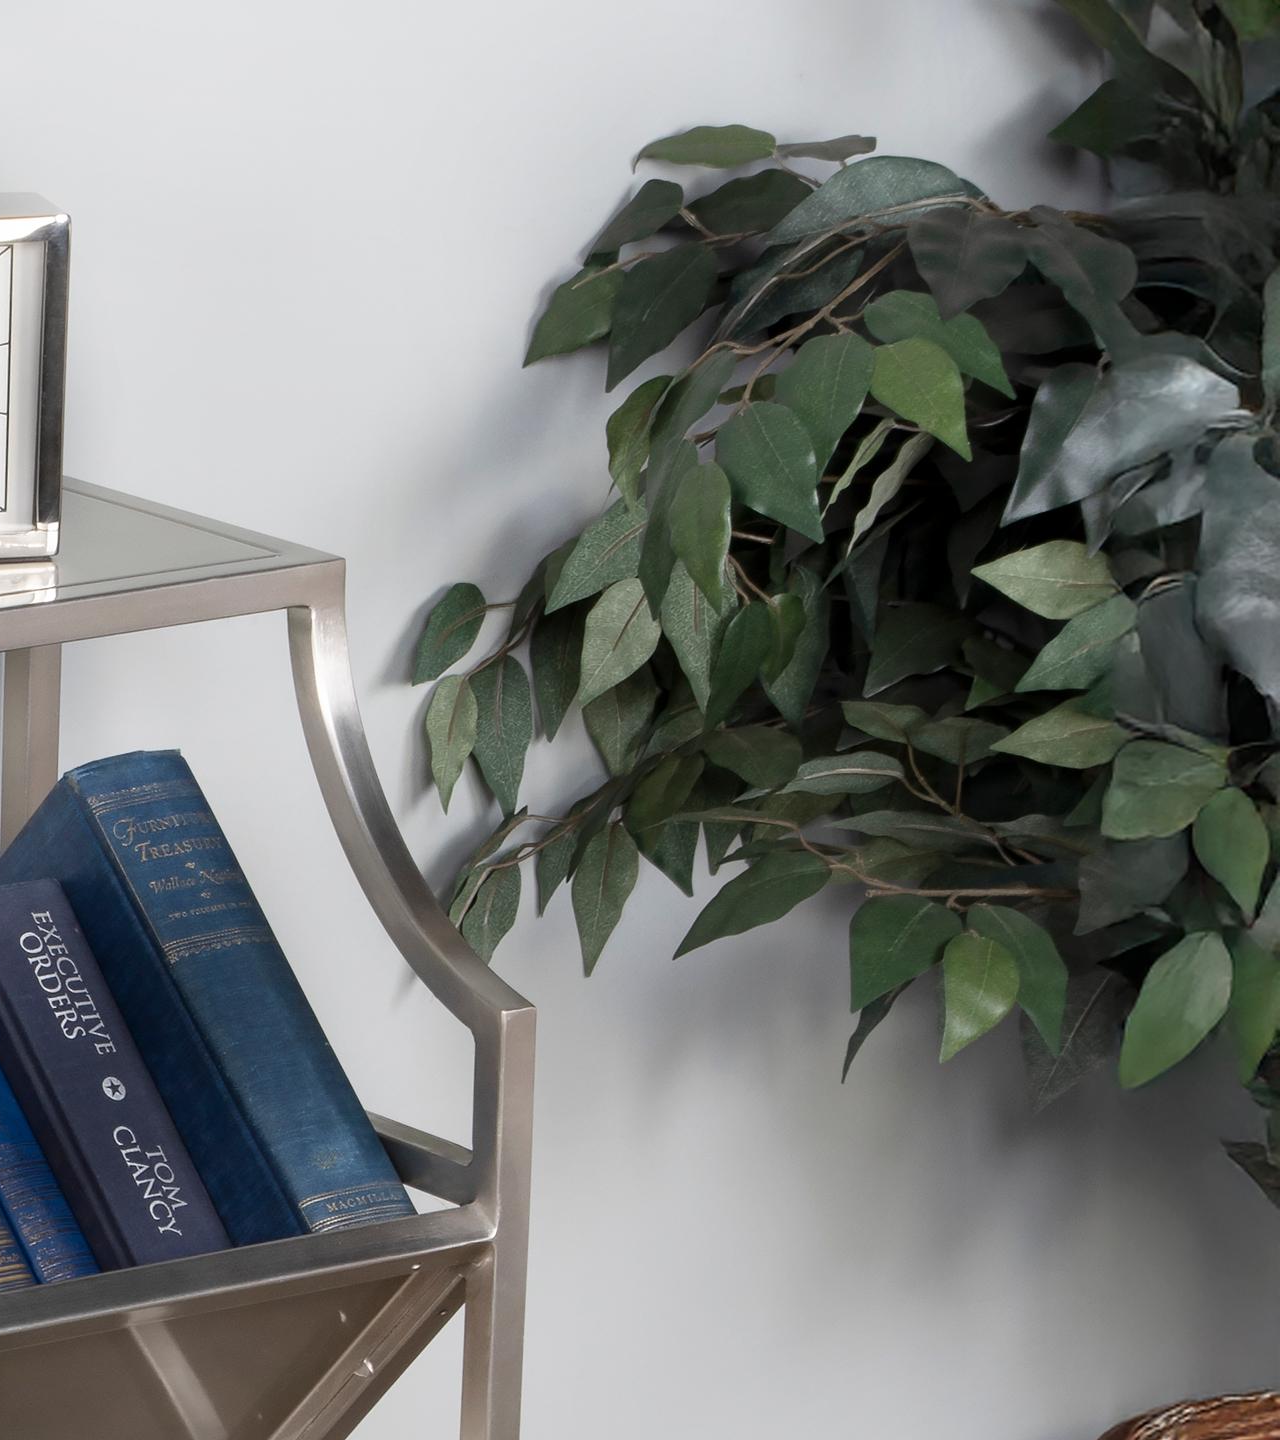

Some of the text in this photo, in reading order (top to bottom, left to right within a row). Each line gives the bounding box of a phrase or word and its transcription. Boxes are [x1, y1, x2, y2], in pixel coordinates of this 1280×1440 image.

[19, 931, 87, 1040] ORDERS
[30, 911, 116, 1056] EXECUTIVE
[112, 1125, 183, 1237] CLANCY
[145, 1145, 188, 1212] TOM
